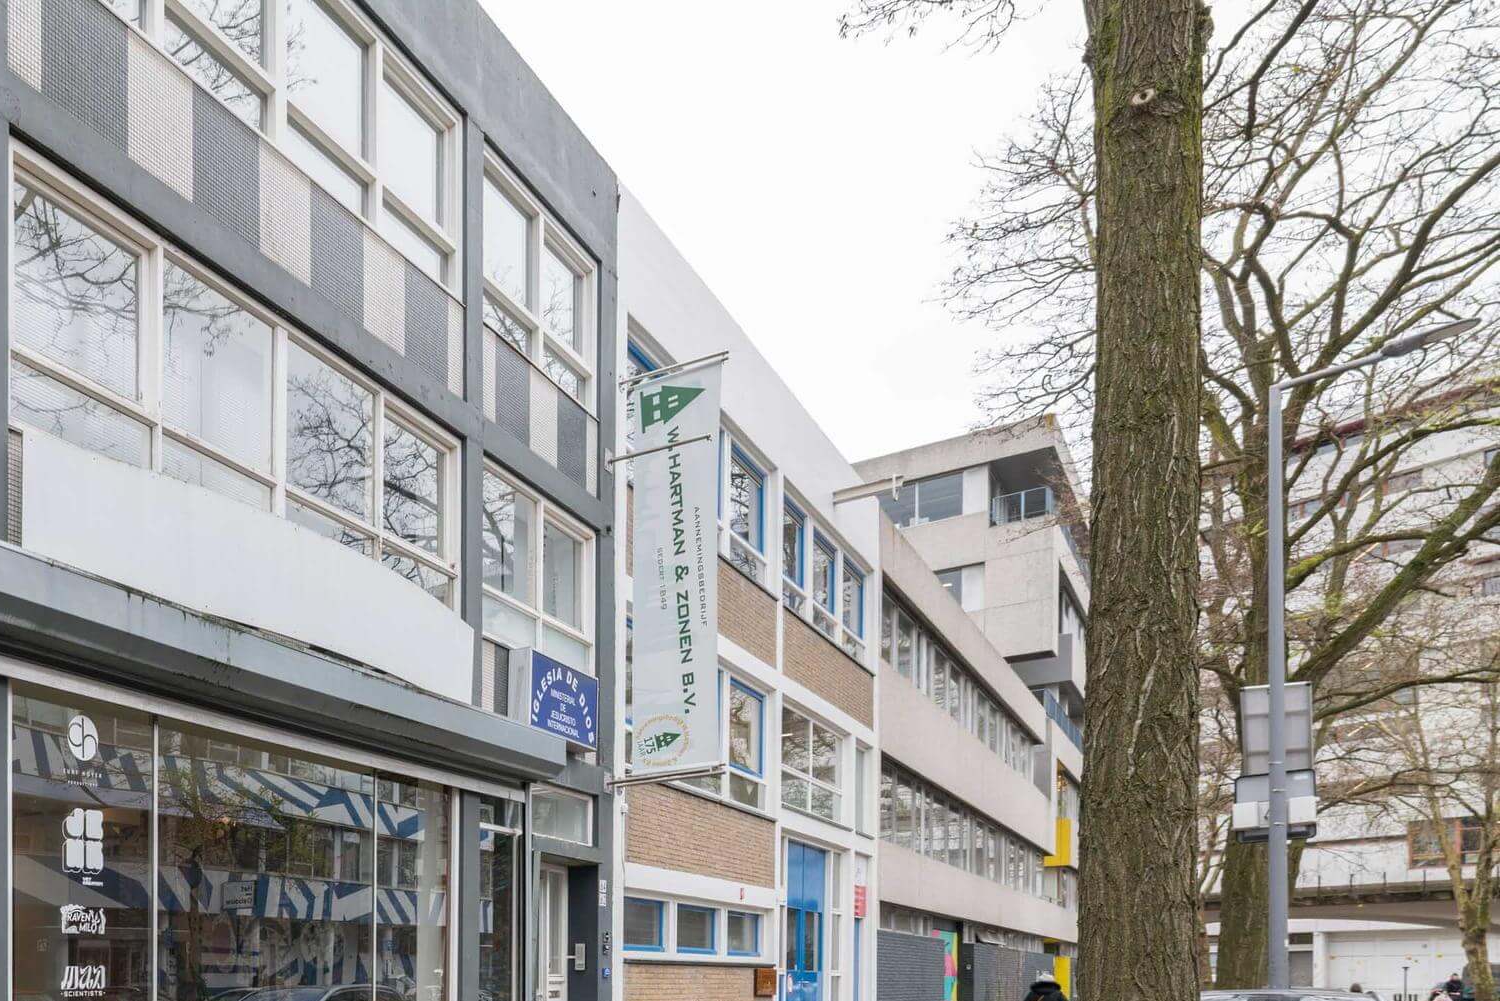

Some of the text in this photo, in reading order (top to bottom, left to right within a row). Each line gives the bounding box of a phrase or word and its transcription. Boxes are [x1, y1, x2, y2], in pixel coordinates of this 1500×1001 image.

[668, 453, 686, 556] HARTMAN
[674, 564, 689, 583] &
[676, 589, 693, 665] ZONEN
[682, 671, 697, 715] B.V.
[531, 667, 563, 723] IGLESIA
[566, 670, 580, 693] DE
[579, 693, 595, 744] DIOS
[644, 736, 657, 755] 175
[67, 912, 91, 923] RAVEN
[79, 922, 98, 933] MILO
[63, 990, 104, 998] SCIENTISTS
